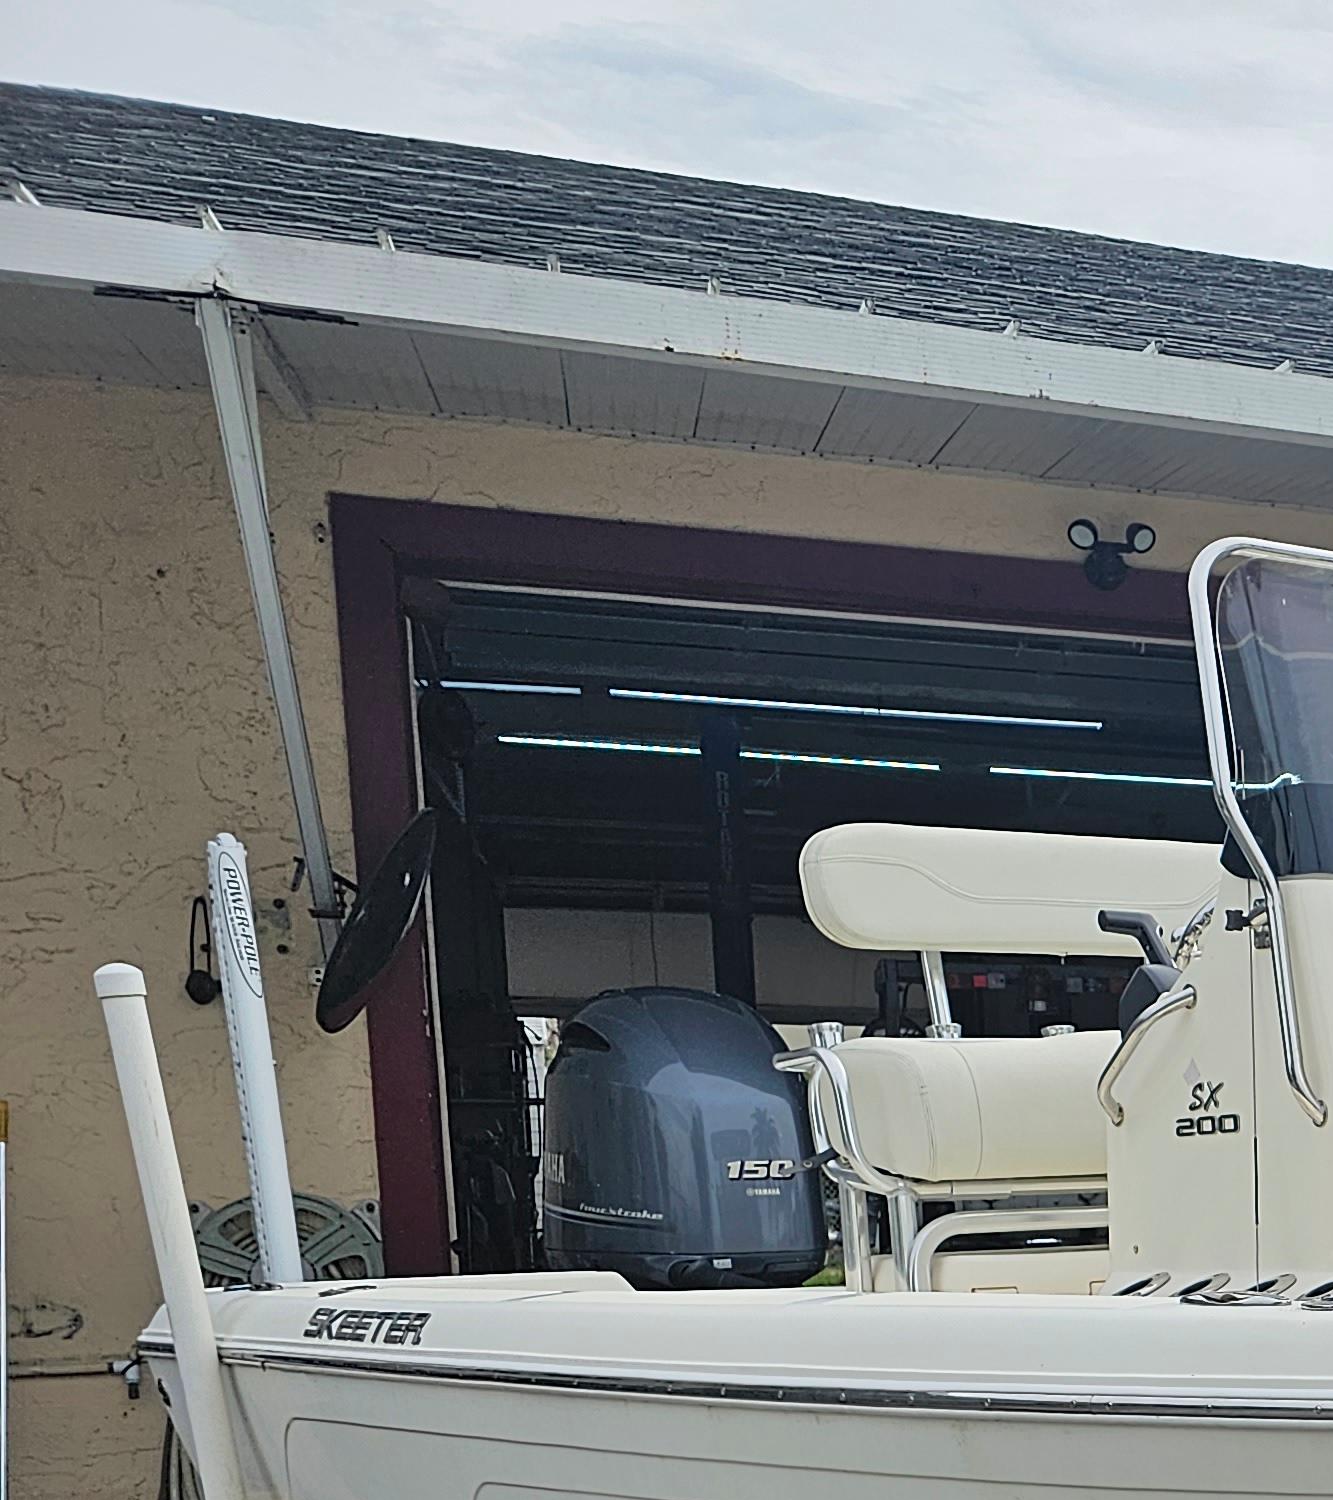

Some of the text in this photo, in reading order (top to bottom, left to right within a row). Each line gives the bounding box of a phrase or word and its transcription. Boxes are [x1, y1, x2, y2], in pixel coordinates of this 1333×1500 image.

[1188, 1080, 1225, 1112] SX
[1175, 1113, 1240, 1137] 200
[727, 1159, 796, 1181] 150
[303, 1307, 432, 1346] SKEETER
